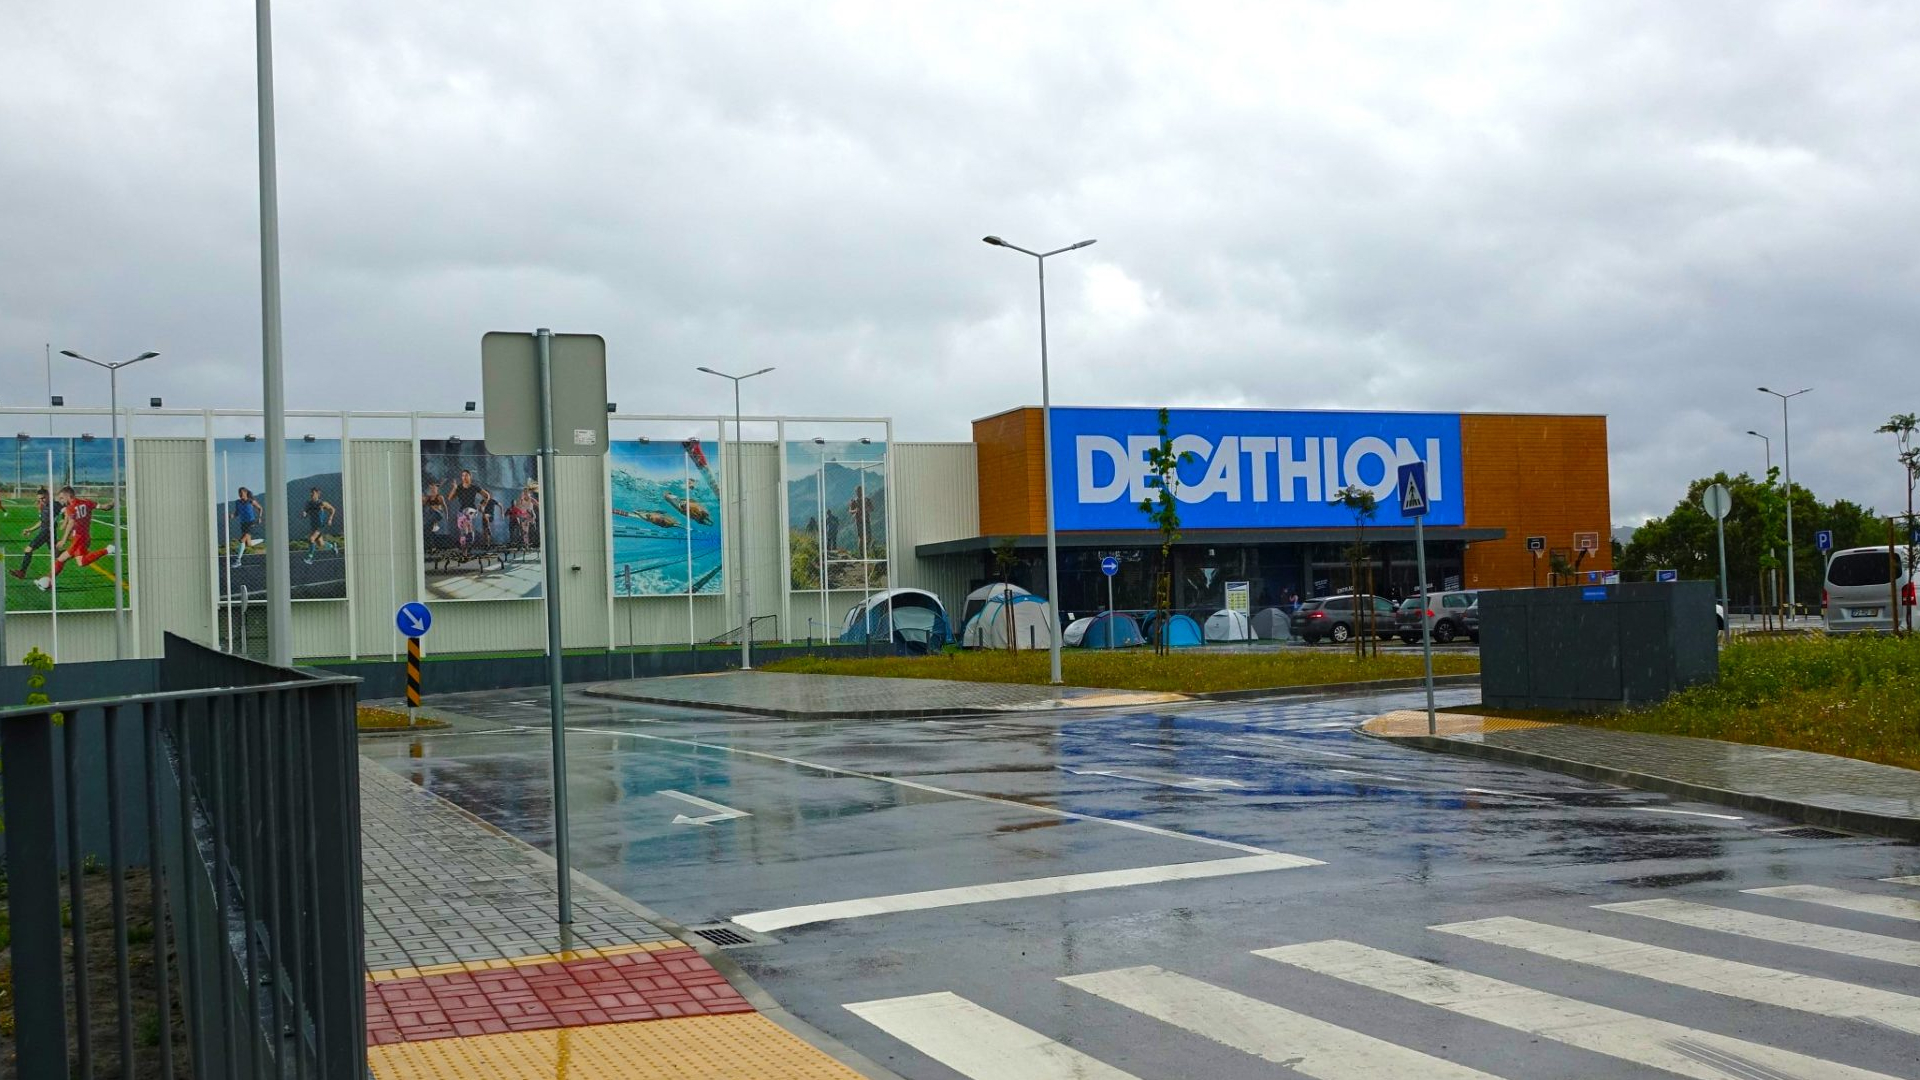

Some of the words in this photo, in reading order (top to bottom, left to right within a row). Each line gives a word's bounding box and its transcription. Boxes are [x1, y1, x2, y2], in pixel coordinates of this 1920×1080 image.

[1076, 434, 1442, 503] DECATHLON
[75, 504, 87, 519] 10
[1819, 533, 1828, 548] P
